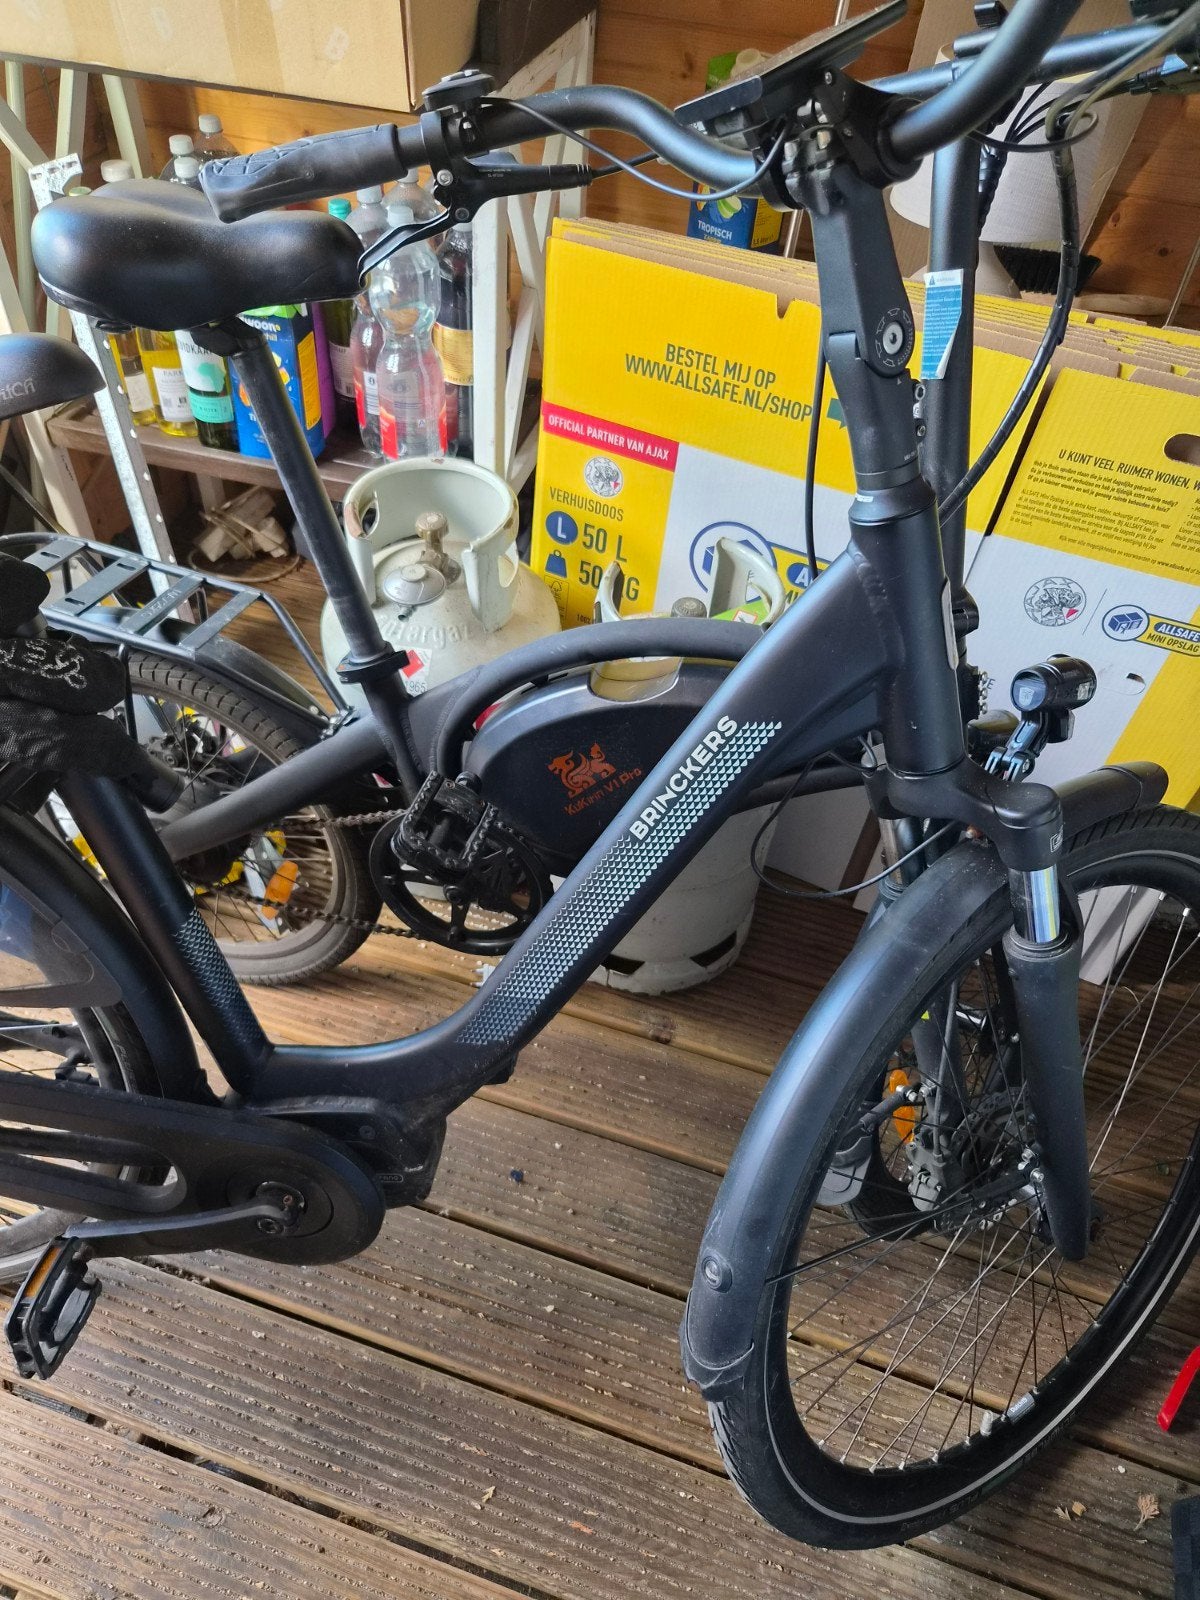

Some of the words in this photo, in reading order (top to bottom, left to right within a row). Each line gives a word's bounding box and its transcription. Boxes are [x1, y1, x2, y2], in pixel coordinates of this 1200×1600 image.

[698, 219, 733, 241] TROPISCH
[666, 343, 719, 375] BESTEL
[723, 359, 752, 385] MIJ
[754, 368, 776, 390] OP
[625, 353, 812, 422] WWW.ALLSAFE.NL/SHOP
[549, 414, 584, 436] OFFICIAL
[587, 426, 625, 448] PARTNER
[627, 437, 645, 454] VAN
[646, 446, 670, 461] AJAX
[1059, 449, 1066, 460] U
[1066, 451, 1093, 466] KUNT
[1093, 456, 1115, 471] VEEL
[1117, 462, 1154, 480] RUIMER
[1155, 471, 1190, 489] WONEN,
[550, 487, 624, 521] VERHUISDOOS
[557, 516, 566, 539] L
[582, 522, 608, 554] 50
[615, 534, 627, 563] L
[578, 560, 604, 589] 50
[621, 574, 640, 602] G
[1146, 633, 1165, 644] MINI
[1167, 640, 1200, 653] OPSLAG
[1158, 623, 1200, 642] ALLSAFE
[619, 768, 641, 784] Pro
[629, 715, 738, 841] BRINCKERS
